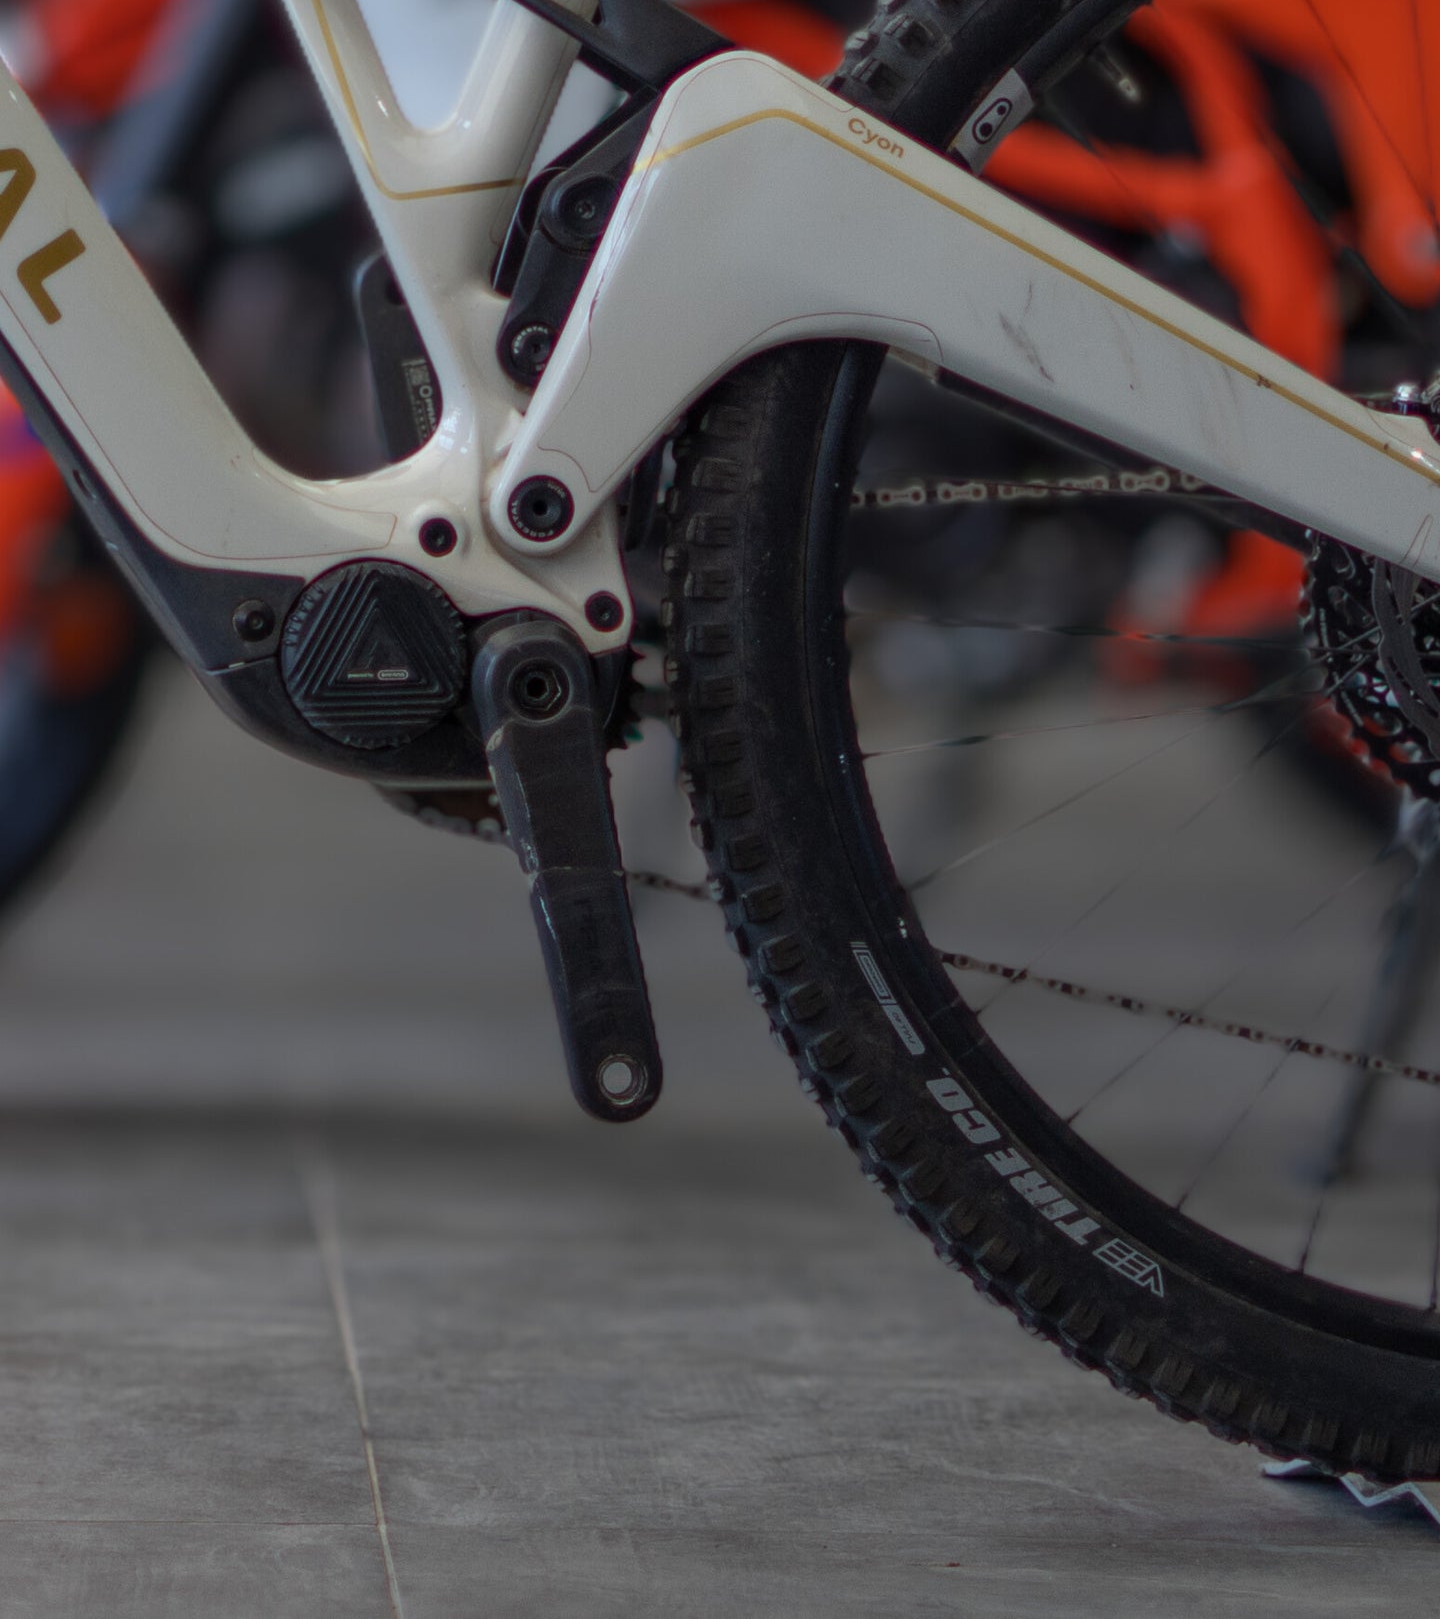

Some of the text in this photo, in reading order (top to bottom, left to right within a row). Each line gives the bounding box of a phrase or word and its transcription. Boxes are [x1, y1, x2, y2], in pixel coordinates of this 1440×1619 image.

[847, 117, 905, 159] Cyon
[984, 1147, 1103, 1246] TIRE
[1093, 1237, 1164, 1298] VEE
